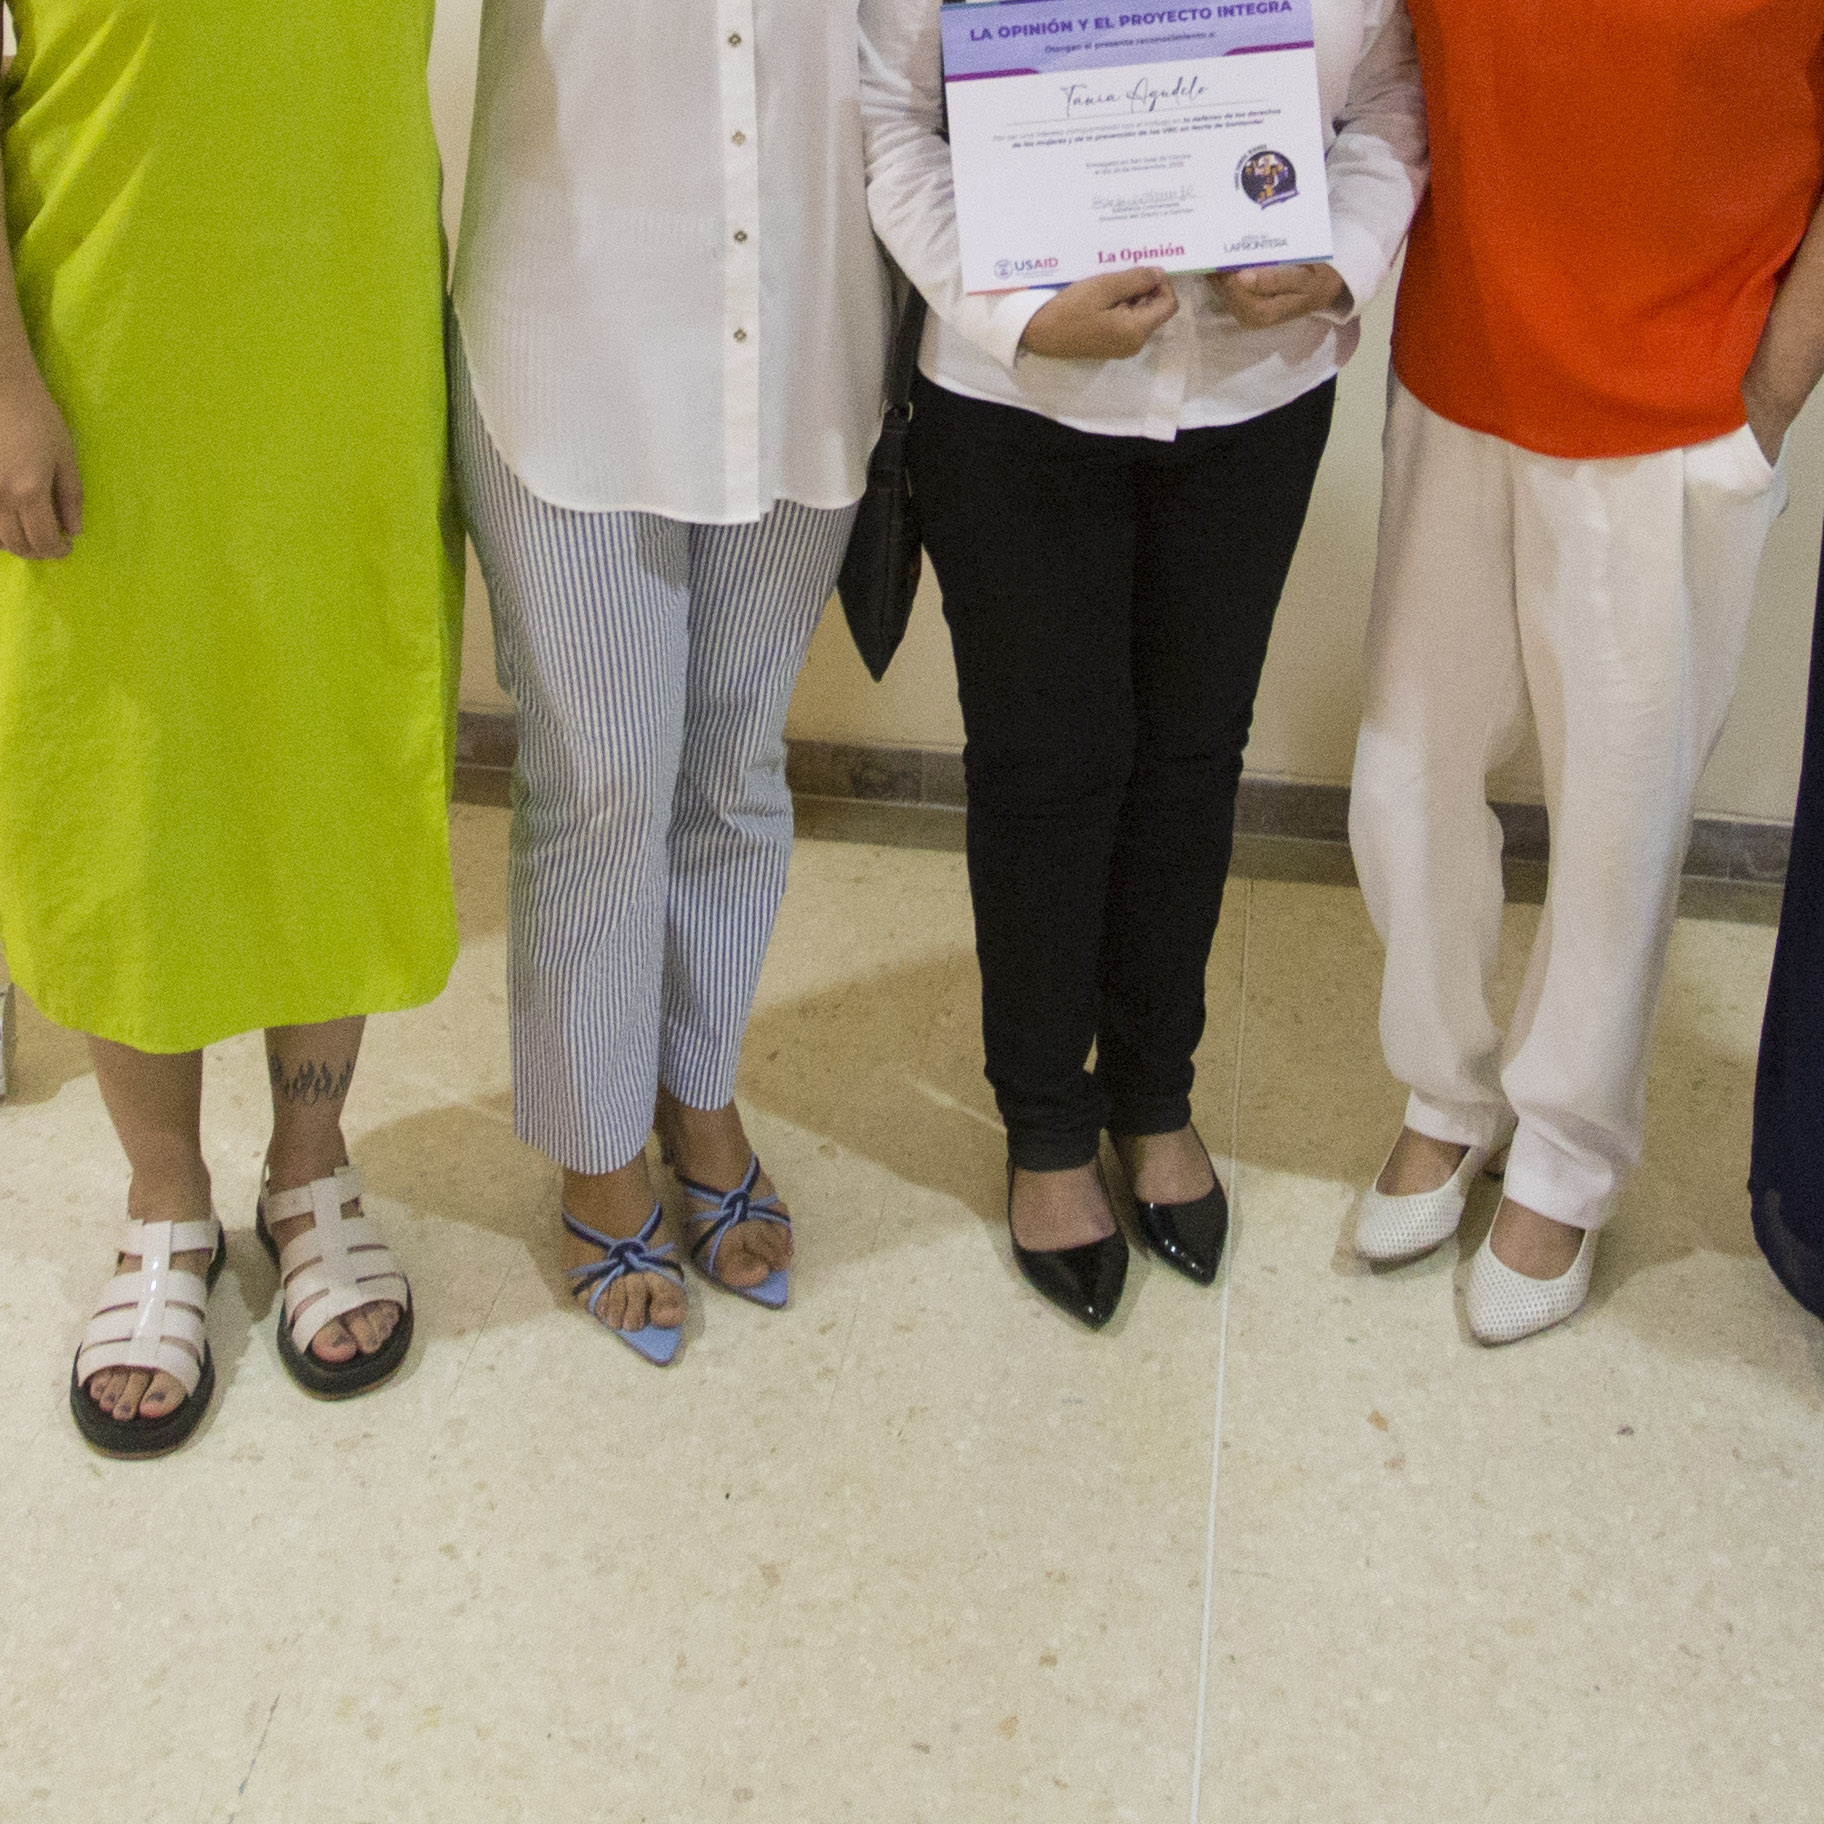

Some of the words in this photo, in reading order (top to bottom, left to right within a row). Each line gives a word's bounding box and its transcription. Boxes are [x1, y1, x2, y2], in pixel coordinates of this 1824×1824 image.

[970, 28, 992, 41] LA
[998, 19, 1073, 38] OPINIÓN
[1078, 19, 1089, 30] Y
[1094, 17, 1115, 29] EL
[1119, 7, 1212, 26] PROYECTO
[1217, 0, 1293, 18] INTEGRA
[1060, 83, 1120, 117] Tania
[1127, 76, 1208, 113] Agudelo
[1014, 257, 1059, 272] USAID
[1098, 250, 1116, 264] La
[1120, 242, 1185, 264] Opinión
